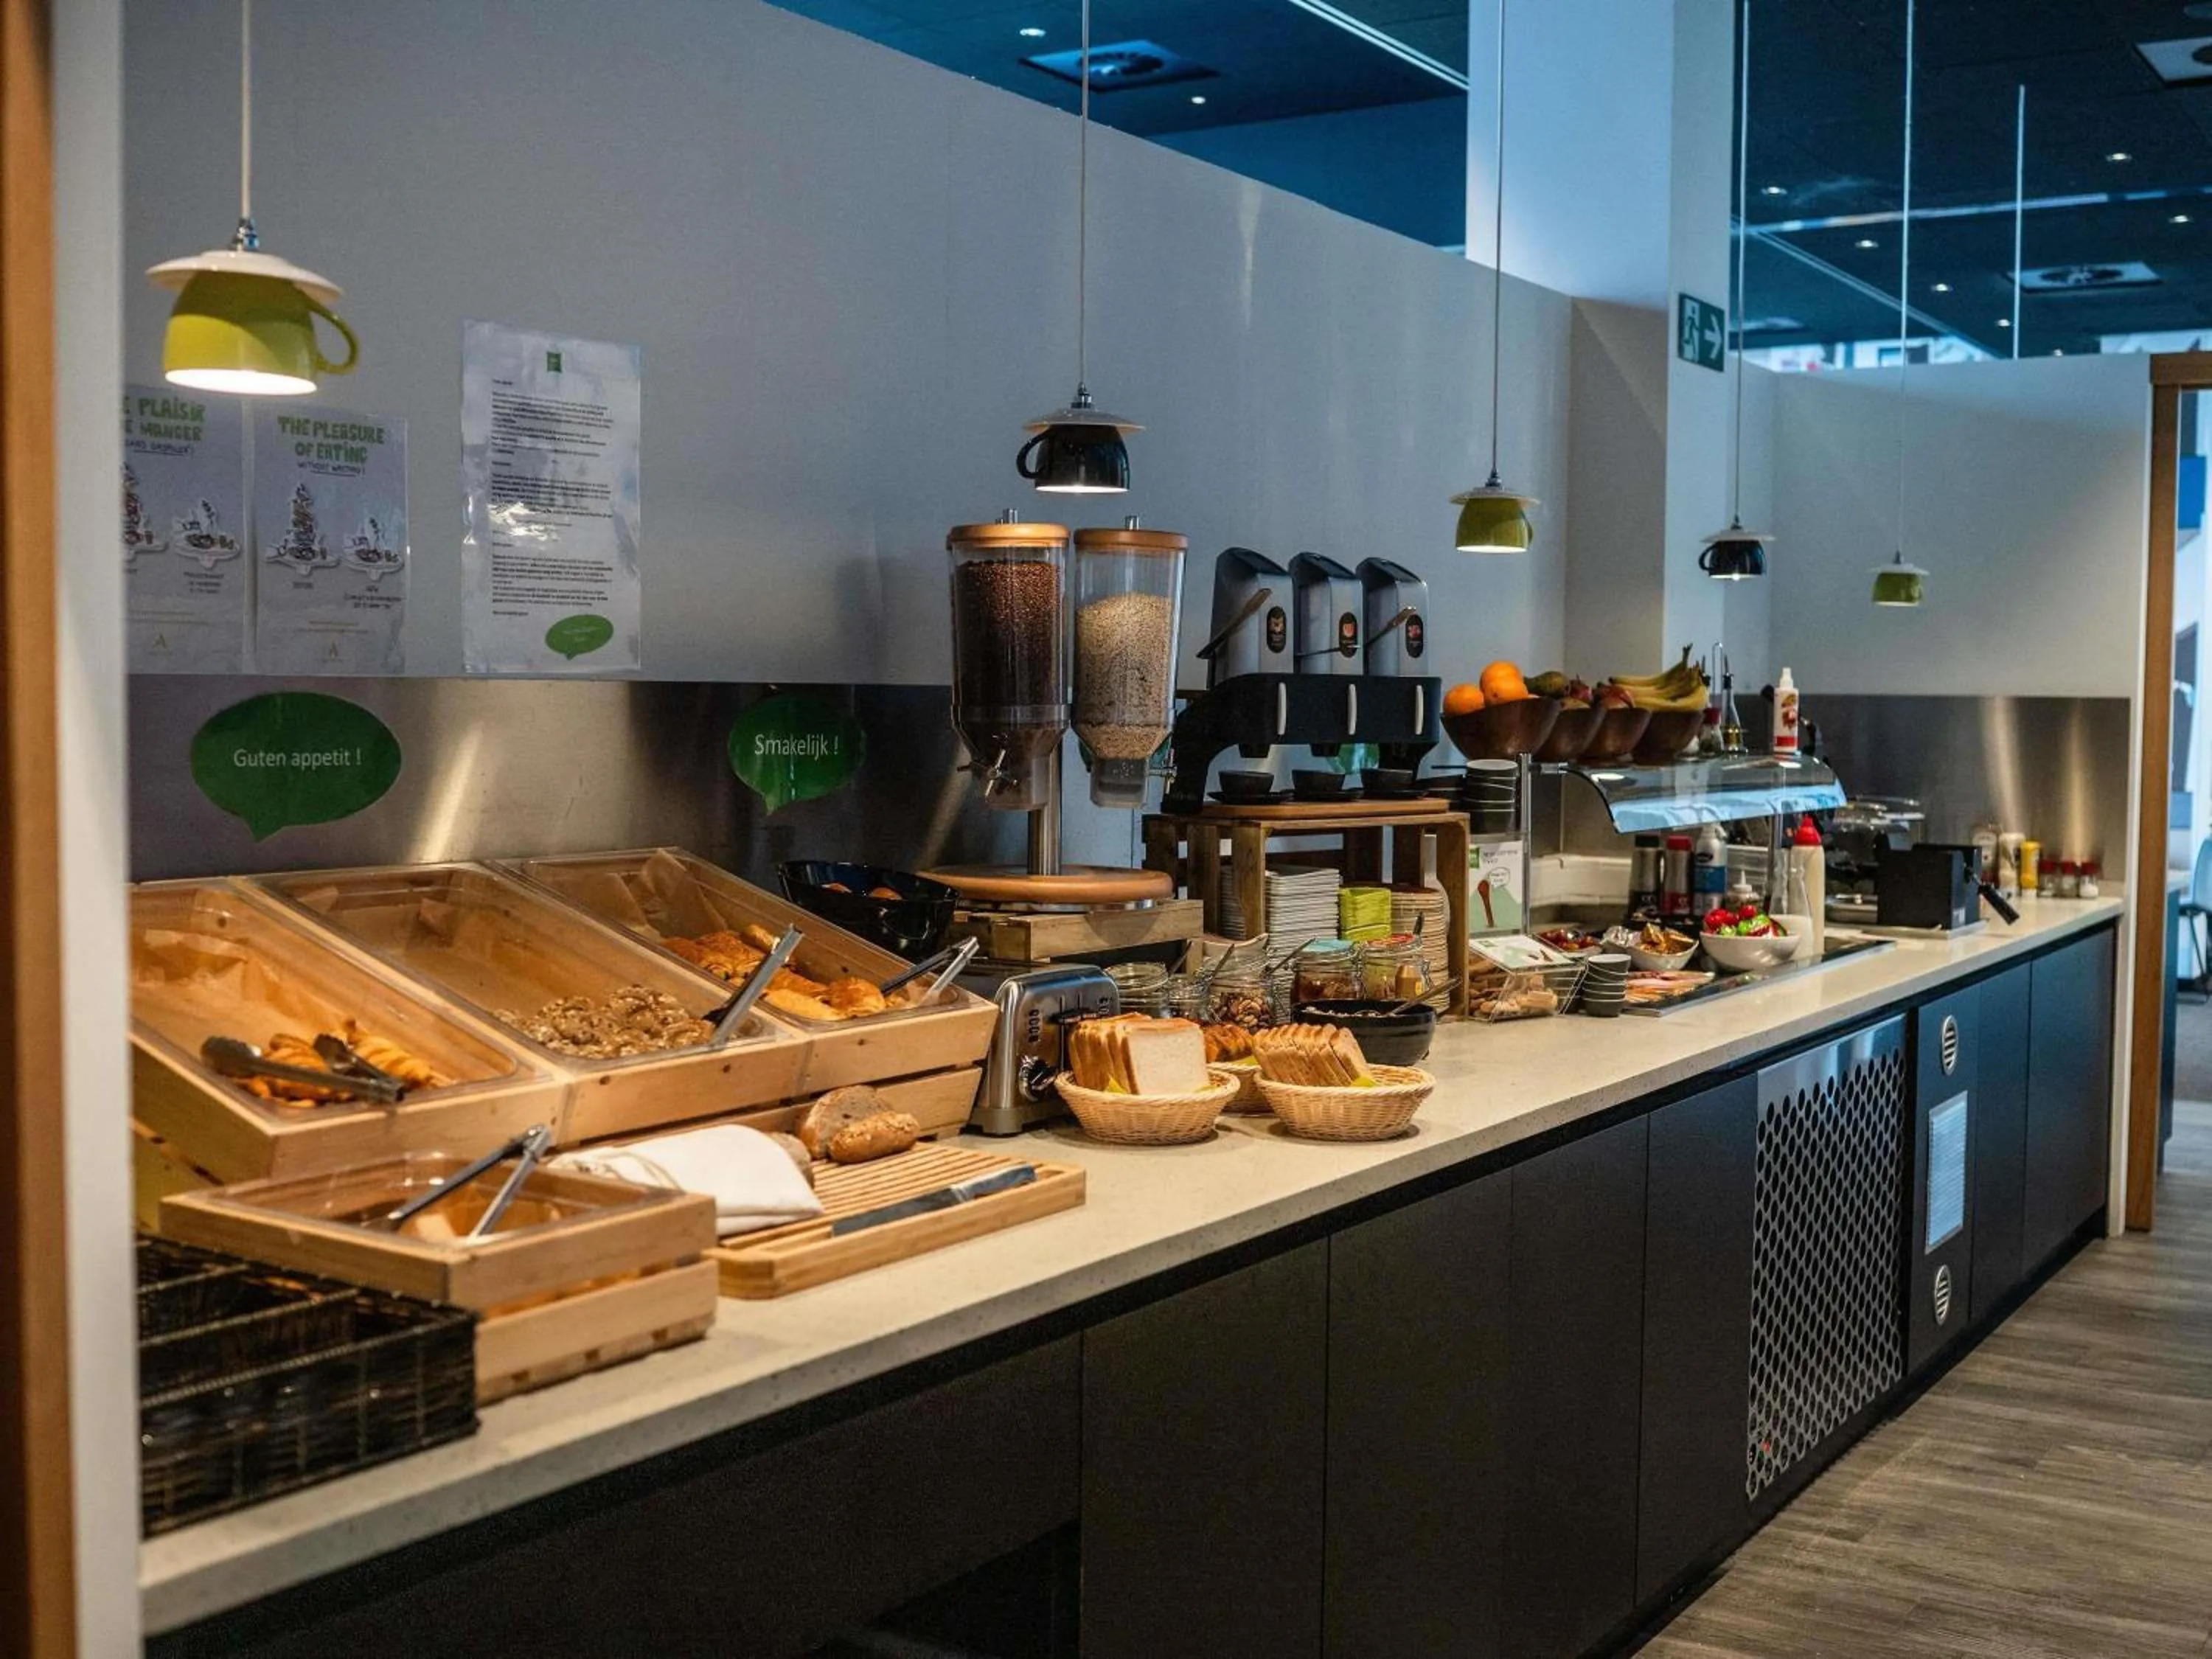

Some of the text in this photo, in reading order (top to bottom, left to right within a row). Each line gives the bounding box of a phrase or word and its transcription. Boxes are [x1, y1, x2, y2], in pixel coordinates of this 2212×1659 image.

[277, 416, 384, 444] THE PLEASURE
[295, 442, 313, 457] OF
[234, 748, 286, 767] Guten
[291, 748, 351, 771] appetit
[754, 734, 828, 761] Smakelijk
